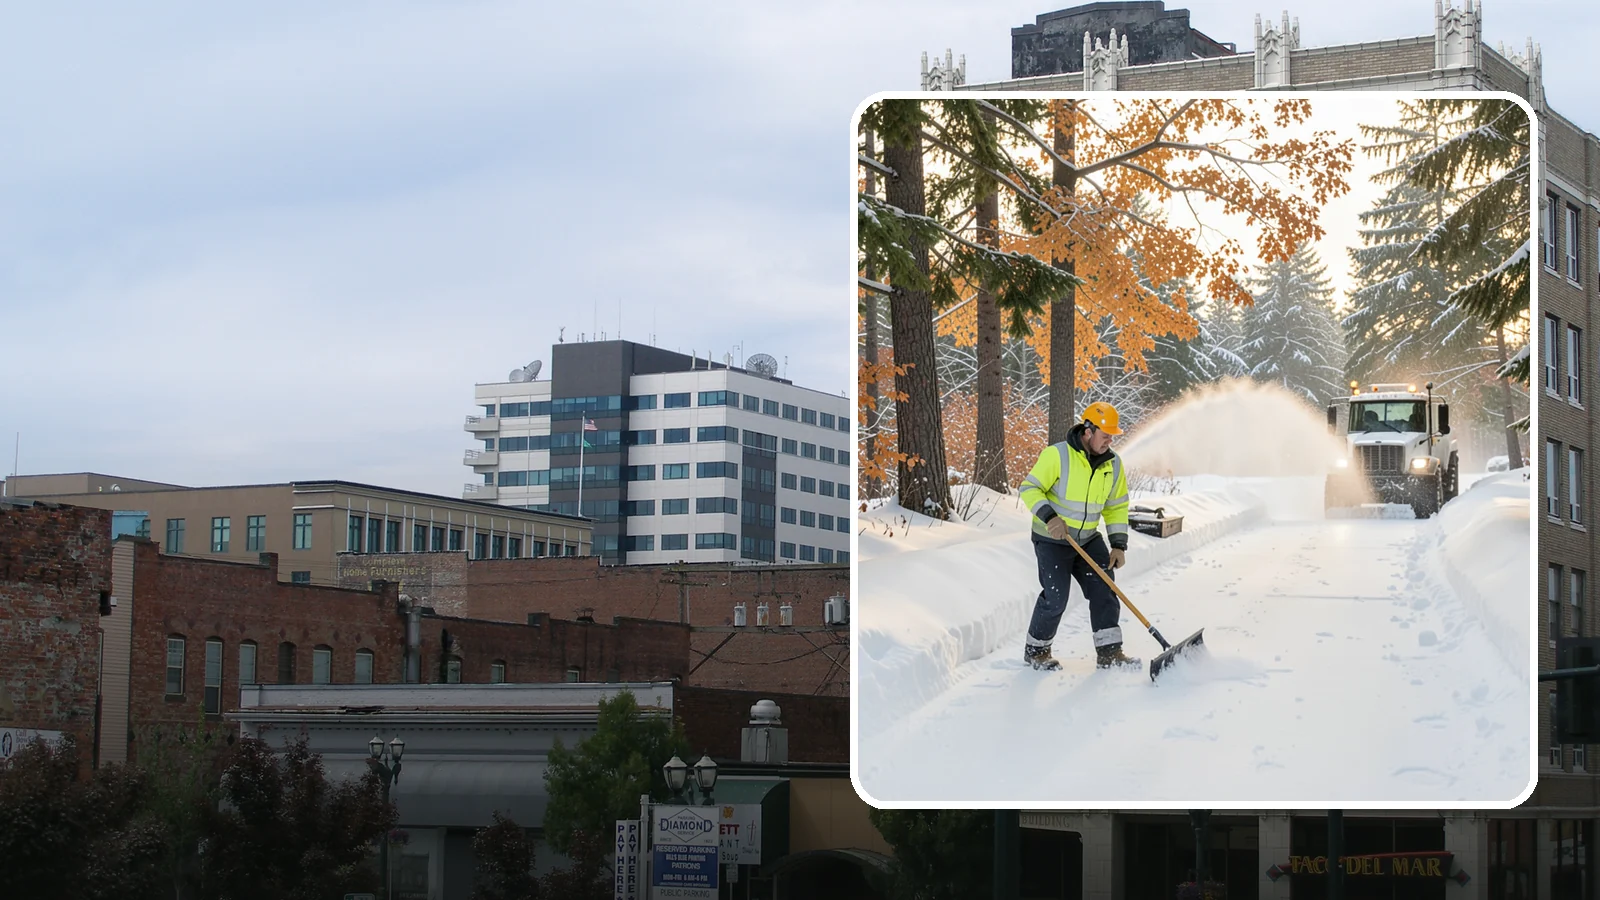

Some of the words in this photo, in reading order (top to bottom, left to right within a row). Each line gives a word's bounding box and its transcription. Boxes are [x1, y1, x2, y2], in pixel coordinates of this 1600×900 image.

[343, 568, 367, 577] Home
[370, 566, 427, 576] Furnishers
[660, 818, 713, 832] DIAMOND
[1022, 815, 1070, 828] BUILDING
[617, 825, 625, 852] PAY
[628, 824, 637, 852] PAY
[655, 845, 688, 853] RESERVED
[689, 846, 716, 854] PARKING
[671, 862, 701, 870] PATRONS
[1346, 856, 1385, 875] DEL
[1392, 857, 1443, 876] MAR
[616, 856, 625, 894] HERE
[627, 856, 637, 893] HERE
[660, 888, 682, 897] PUBLIC
[683, 889, 710, 898] PARKING
